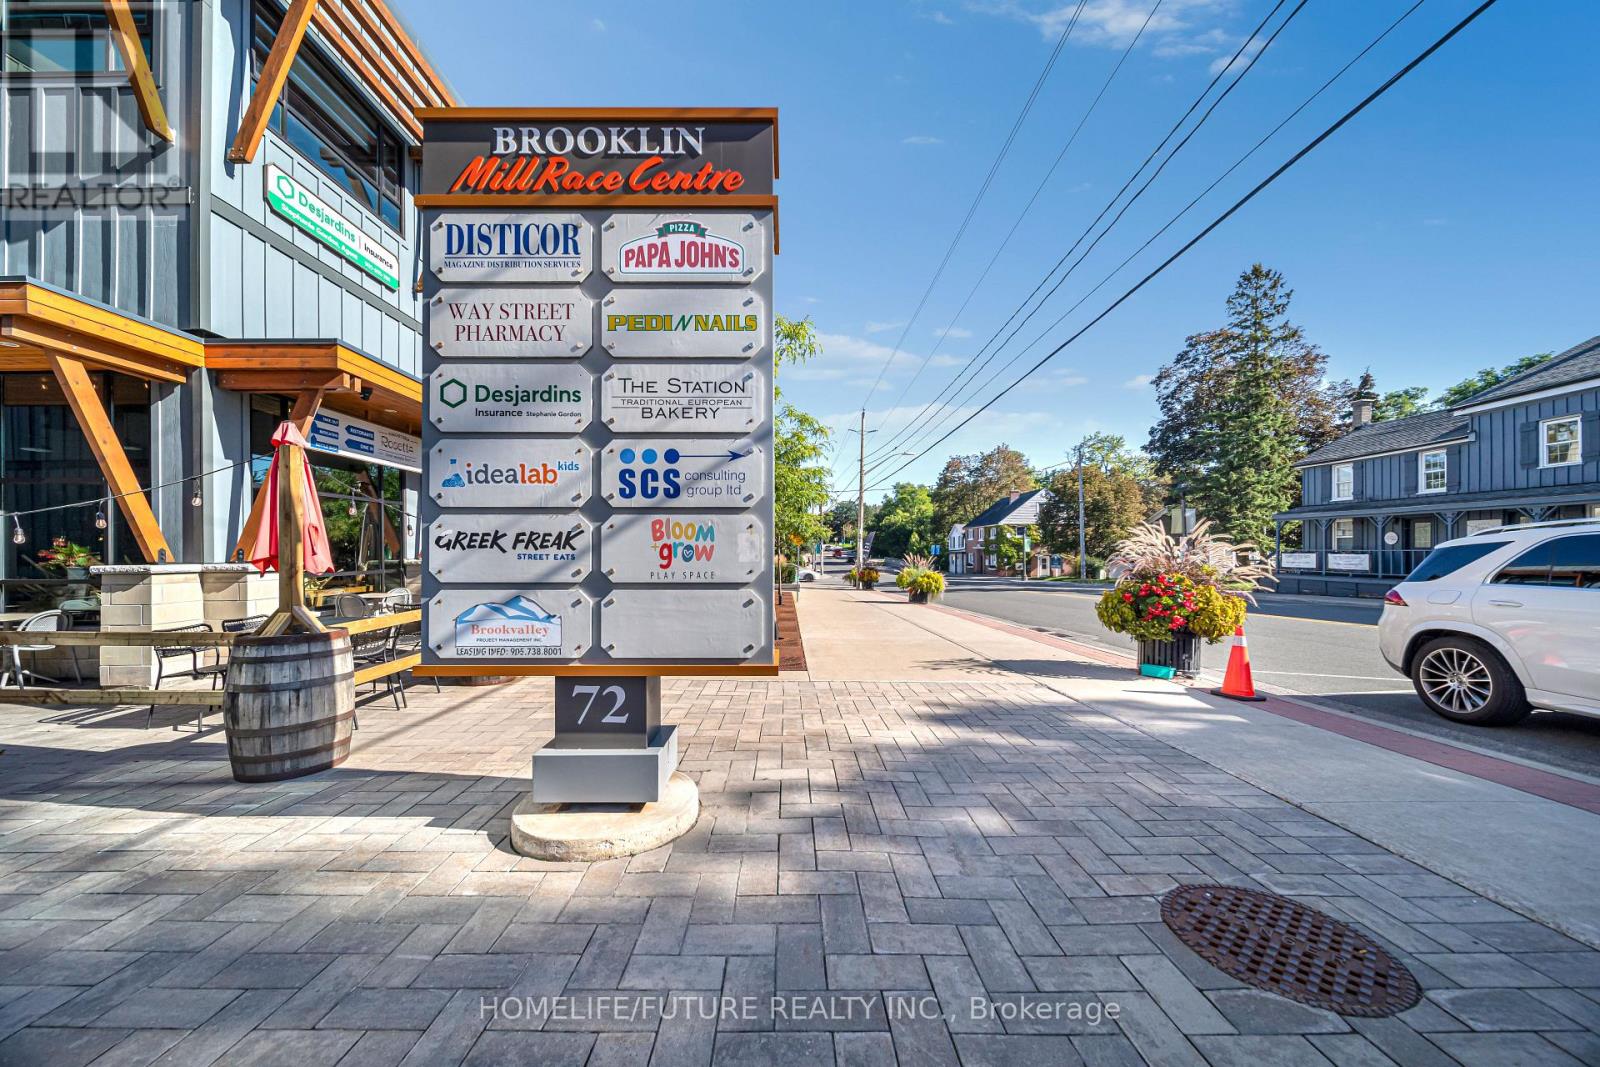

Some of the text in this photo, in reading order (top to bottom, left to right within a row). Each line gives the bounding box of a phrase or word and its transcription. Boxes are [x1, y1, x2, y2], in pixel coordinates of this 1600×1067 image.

[493, 127, 705, 155] BROOKLIN
[451, 156, 745, 192] Mill Race Centre
[299, 192, 394, 270] Desjardins Insurance
[669, 224, 695, 233] PIZZA
[445, 223, 580, 256] DISTICOR
[624, 240, 740, 268] PAPA JOHN'S
[444, 260, 581, 268] MAGAZINE DISTRIBUTION SERVICES
[449, 303, 575, 320] WAY STREET
[455, 324, 567, 342] PHARMACY
[475, 384, 582, 406] Desjardins
[618, 378, 746, 394] THE STATION
[475, 408, 523, 417] Insurance
[641, 407, 720, 419] BAKERY
[466, 461, 580, 484] idealab kids
[618, 468, 746, 499] SCS consulting
[686, 485, 741, 498] group ltd
[435, 529, 584, 554] GREEK FREAK
[517, 553, 576, 561] STREET EATS
[659, 542, 715, 570] grow
[650, 571, 716, 580] PLAY SPACE
[471, 624, 549, 636] Brookvalley
[456, 648, 562, 656] LEASING INFO: 905.738.8001
[572, 685, 629, 725] 72
